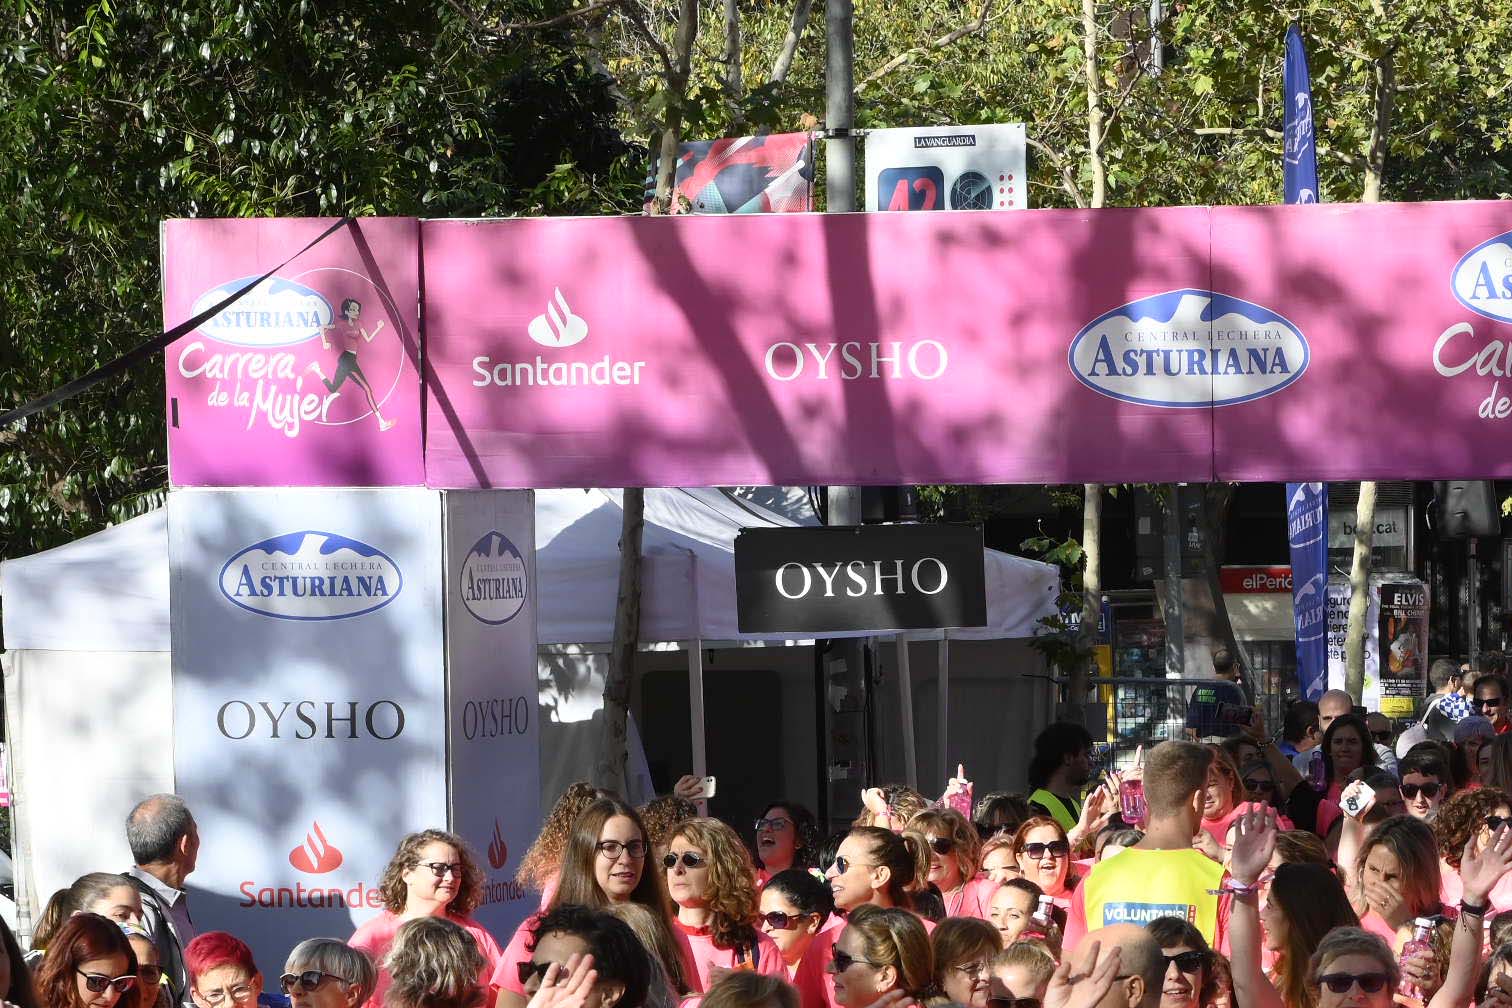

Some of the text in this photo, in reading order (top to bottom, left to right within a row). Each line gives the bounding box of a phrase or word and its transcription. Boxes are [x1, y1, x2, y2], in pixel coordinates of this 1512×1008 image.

[1124, 330, 1200, 343] CENTRAL
[178, 341, 296, 379] Carrera
[472, 354, 646, 387] Santander
[763, 339, 949, 382] OYSHO
[1087, 334, 1292, 377] ASTURIANA
[207, 380, 250, 407] de la
[246, 374, 341, 438] Mujer
[1478, 383, 1512, 420] de
[233, 564, 390, 598] ASTURIANA
[261, 561, 321, 572] CENTRAL
[774, 557, 949, 600] OYSHO
[465, 573, 524, 603] ASTURIANA
[1393, 593, 1425, 606] ELVIS
[216, 700, 406, 740] OYSHO
[463, 695, 529, 741] OYSHO
